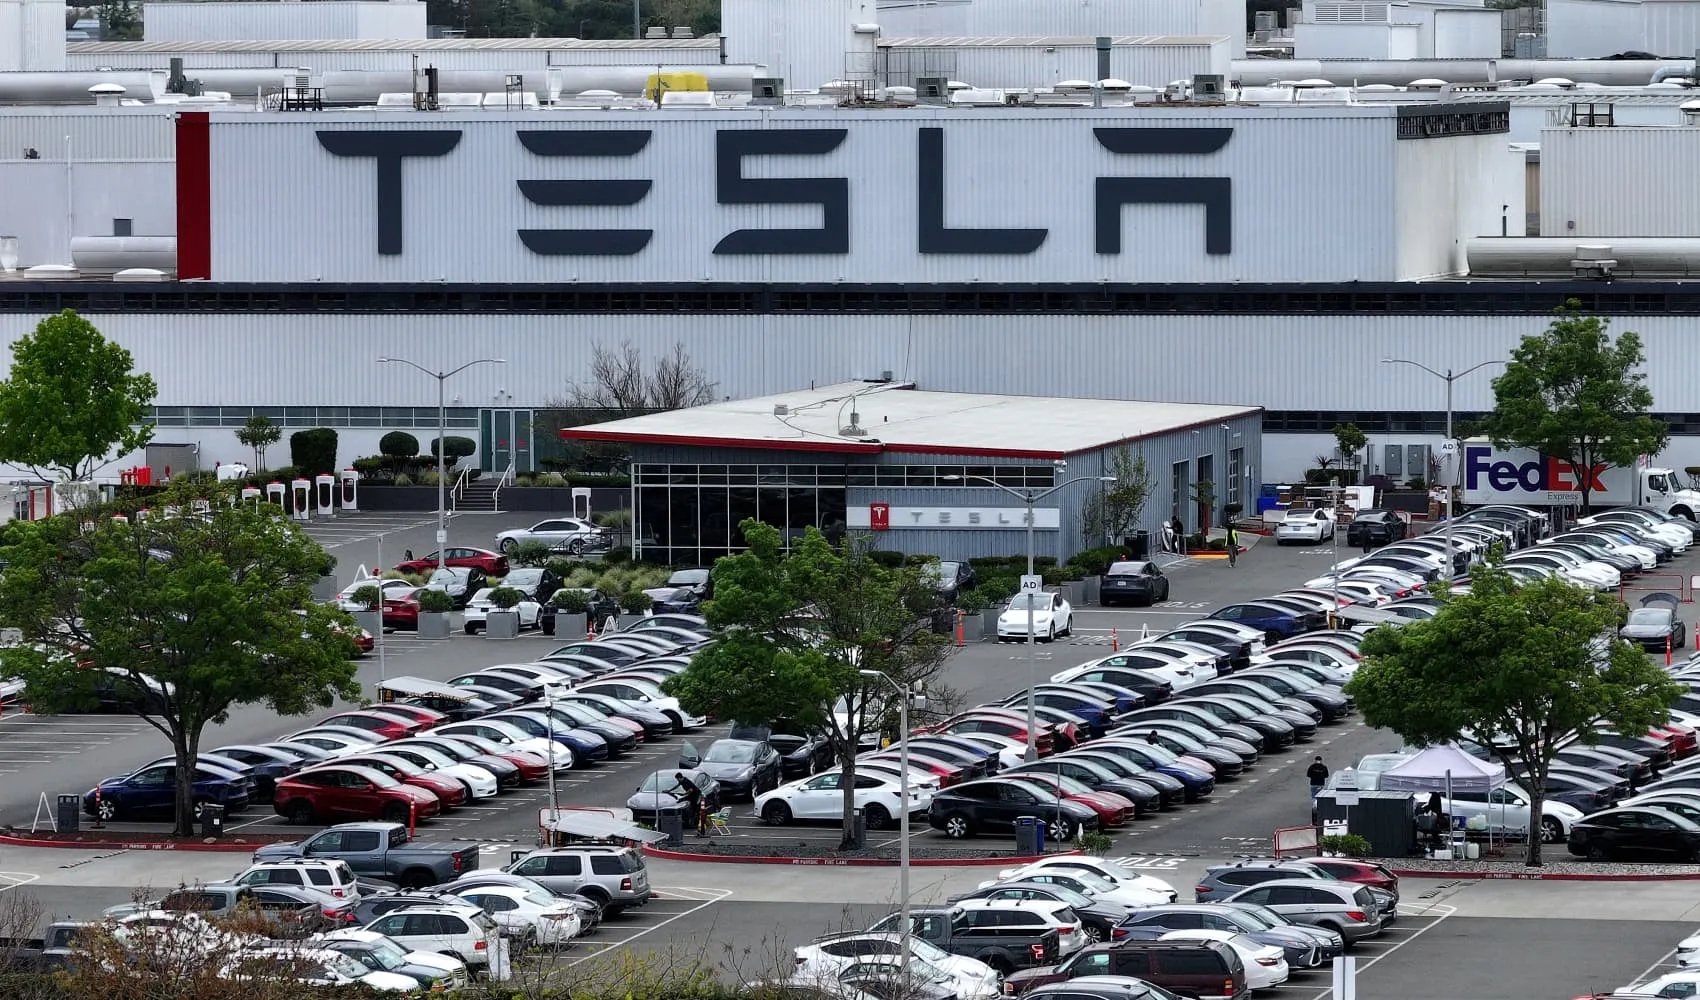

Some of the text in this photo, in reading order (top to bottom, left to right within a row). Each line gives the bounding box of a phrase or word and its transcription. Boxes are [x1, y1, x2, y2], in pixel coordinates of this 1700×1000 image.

[315, 127, 1234, 256] TESLA
[1466, 446, 1608, 492] FedEx
[1547, 492, 1579, 502] Express
[911, 511, 1035, 524] TESLA
[1022, 581, 1037, 589] AD
